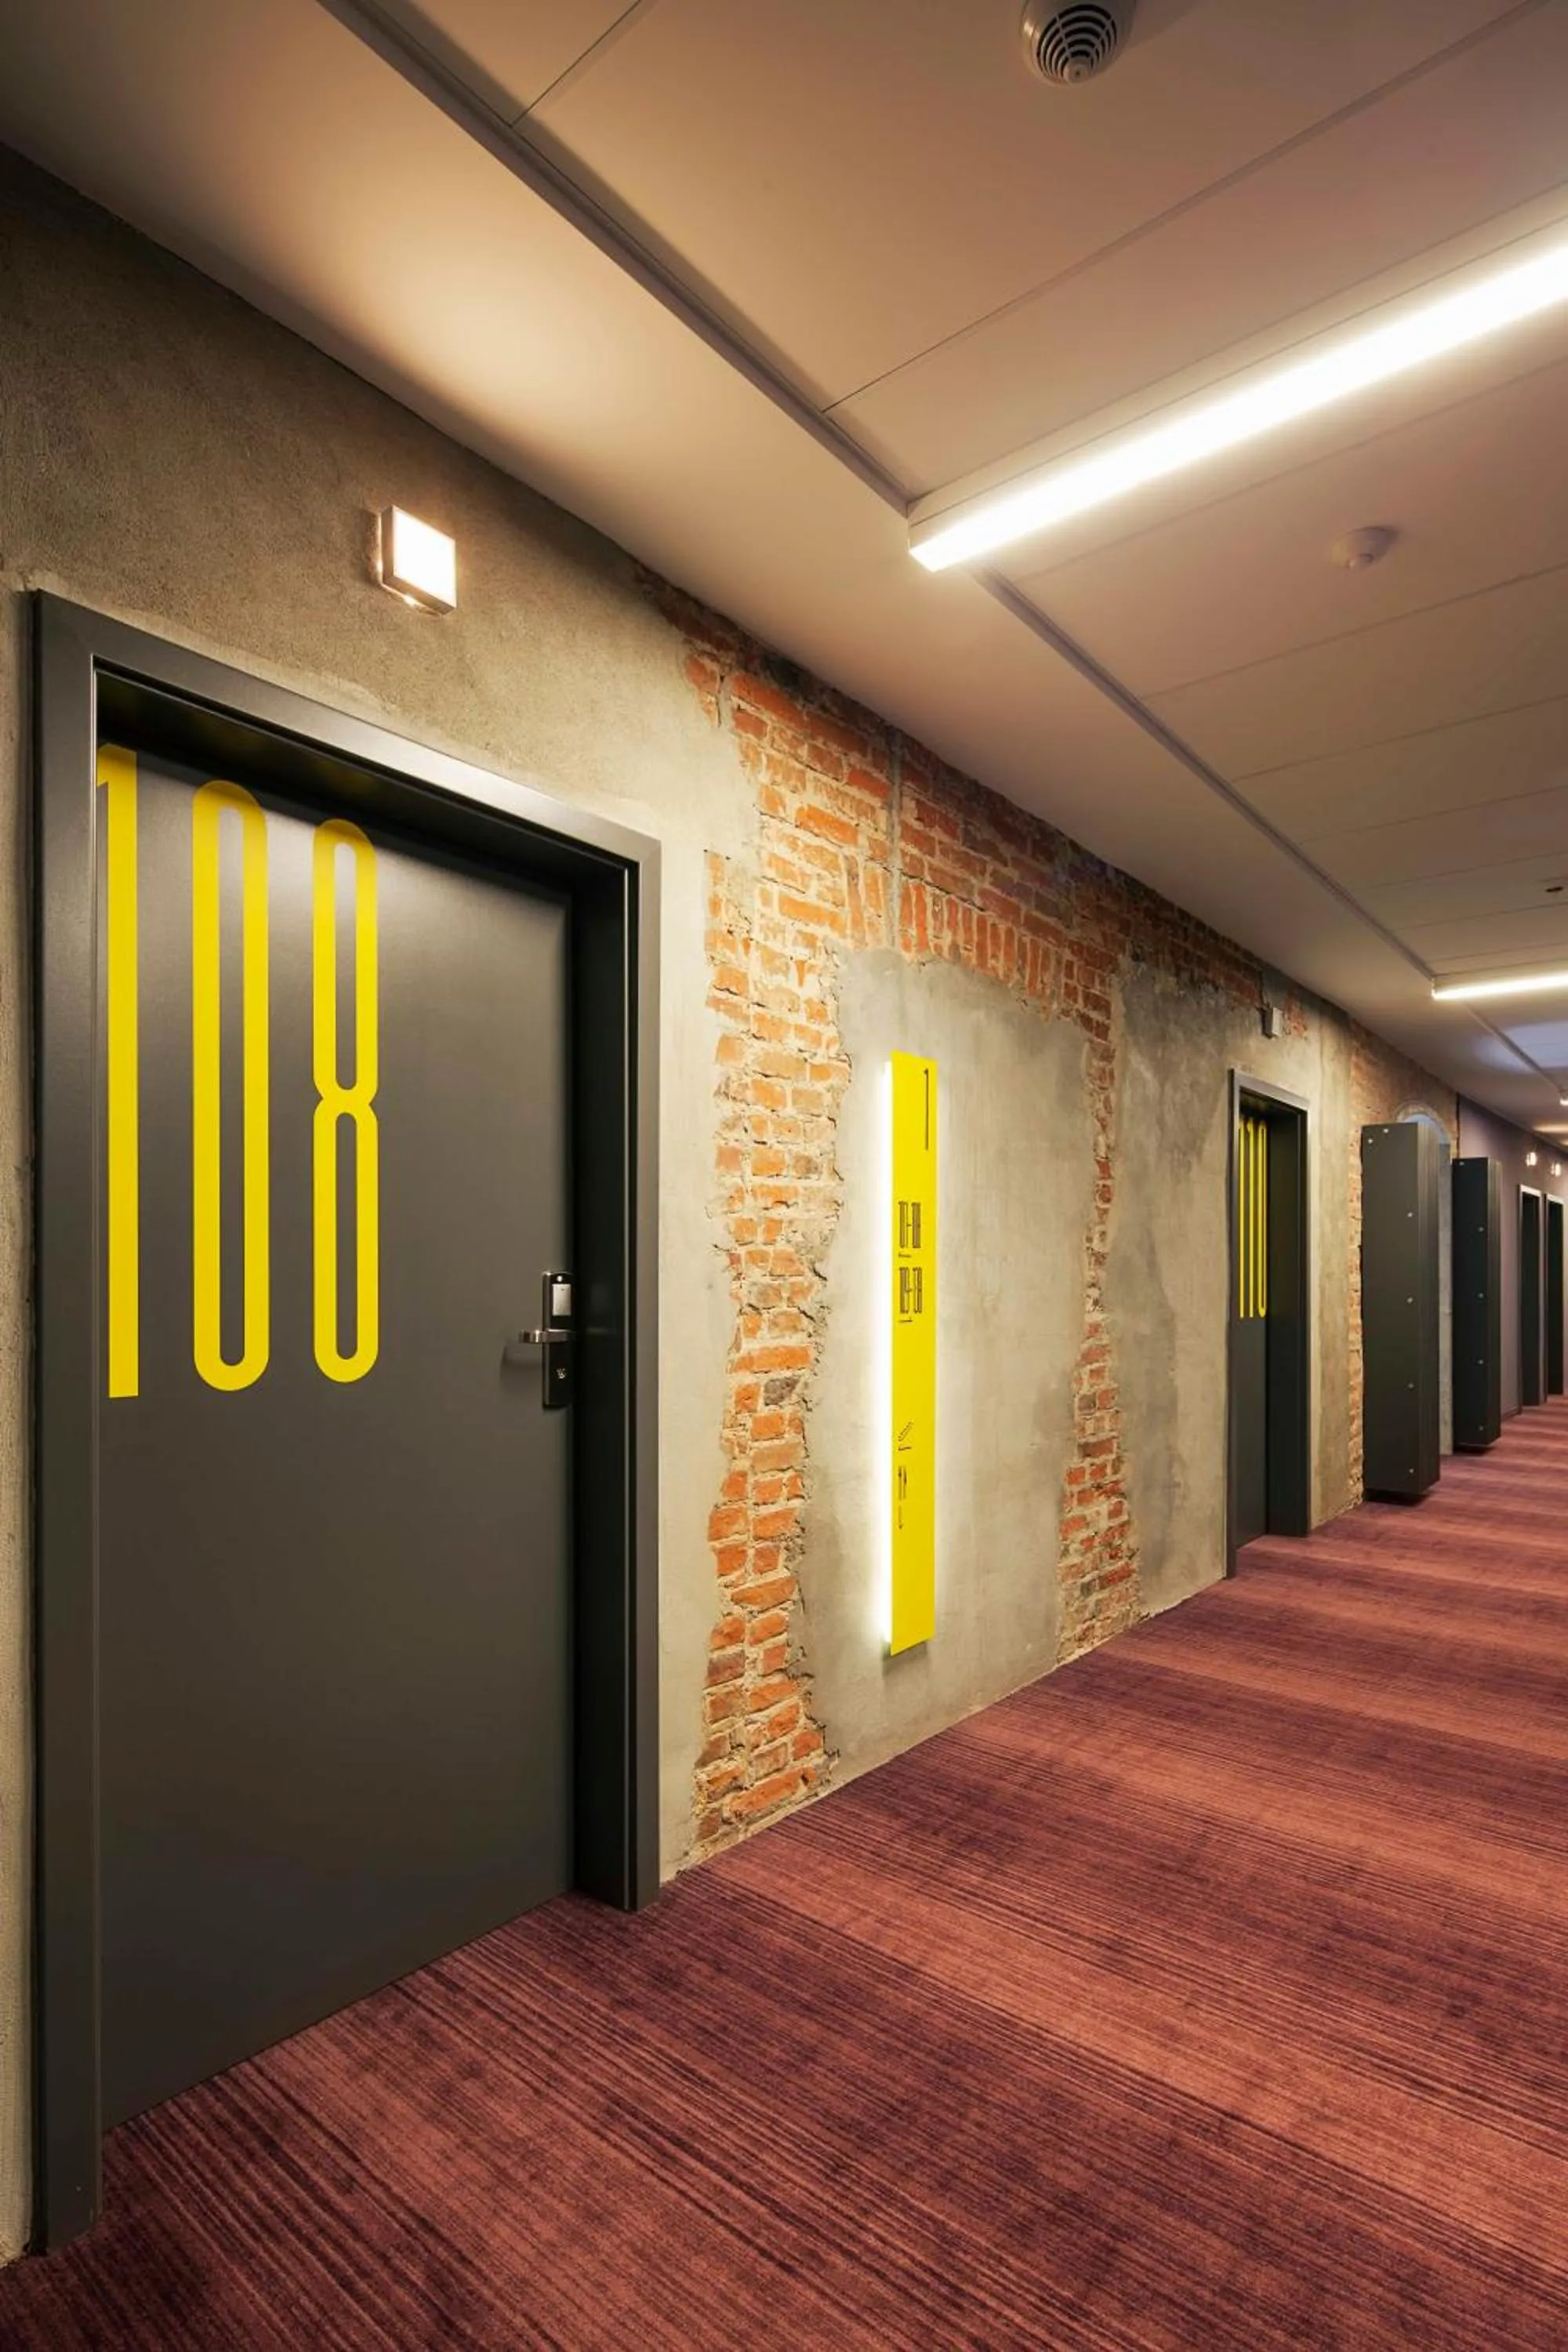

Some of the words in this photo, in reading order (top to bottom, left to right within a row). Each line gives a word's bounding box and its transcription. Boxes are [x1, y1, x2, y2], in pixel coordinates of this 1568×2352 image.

[96, 744, 379, 1399] 108
[923, 1068, 929, 1151] 1
[1239, 1116, 1267, 1318] 110
